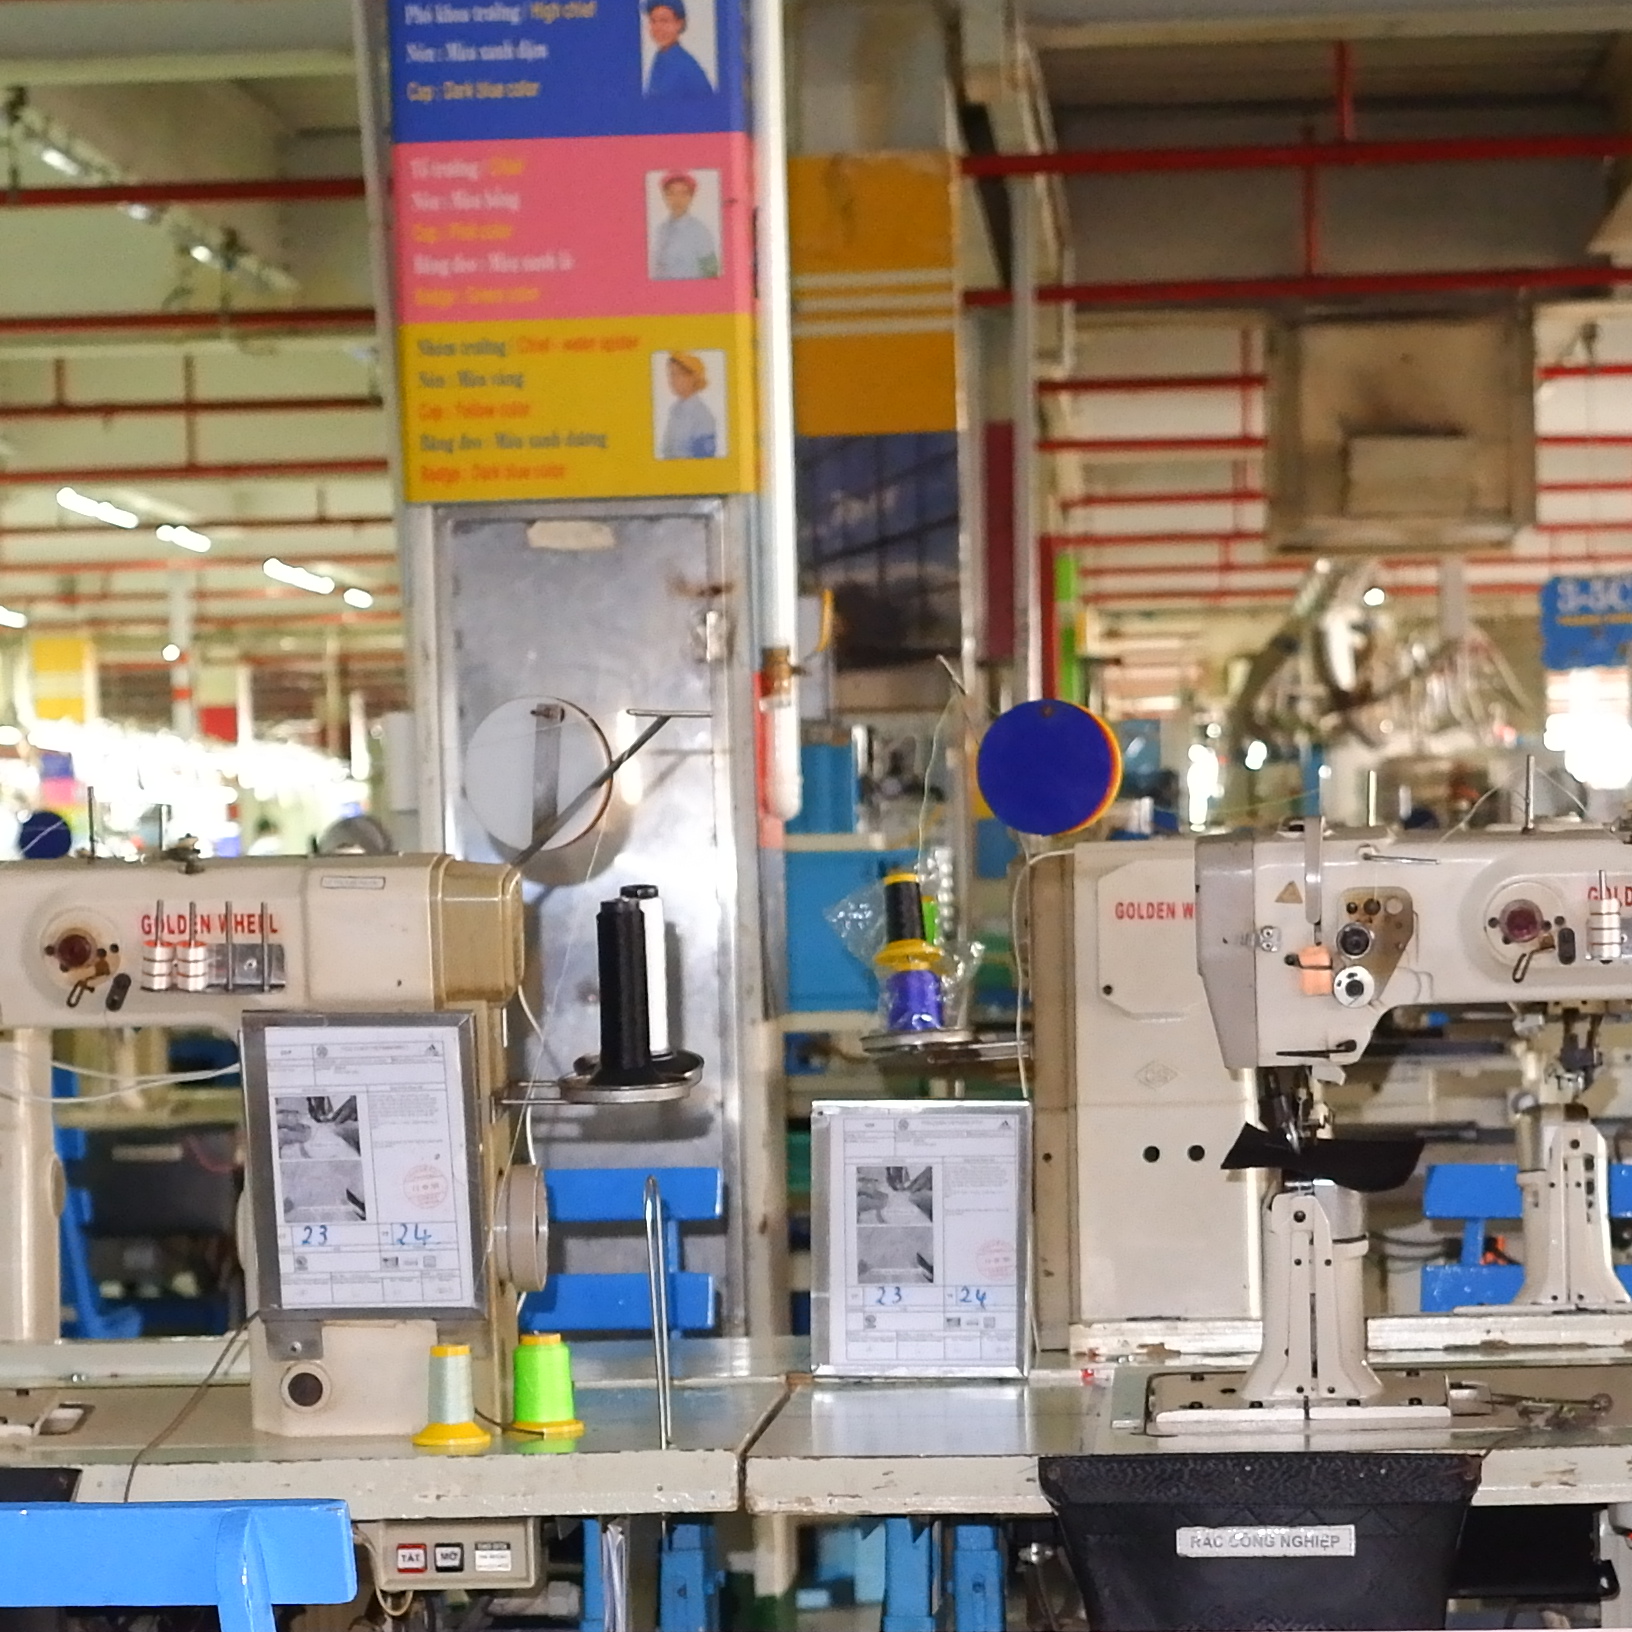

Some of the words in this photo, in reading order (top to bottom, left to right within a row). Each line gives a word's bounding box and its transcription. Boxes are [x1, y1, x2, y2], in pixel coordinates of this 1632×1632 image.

[1115, 901, 1176, 920] GOLDEN
[141, 914, 212, 936] GLDN
[218, 913, 279, 935] WHEL
[302, 1225, 328, 1247] 23
[397, 1223, 432, 1246] 24
[875, 1286, 903, 1306] 23
[959, 1286, 987, 1310] 24
